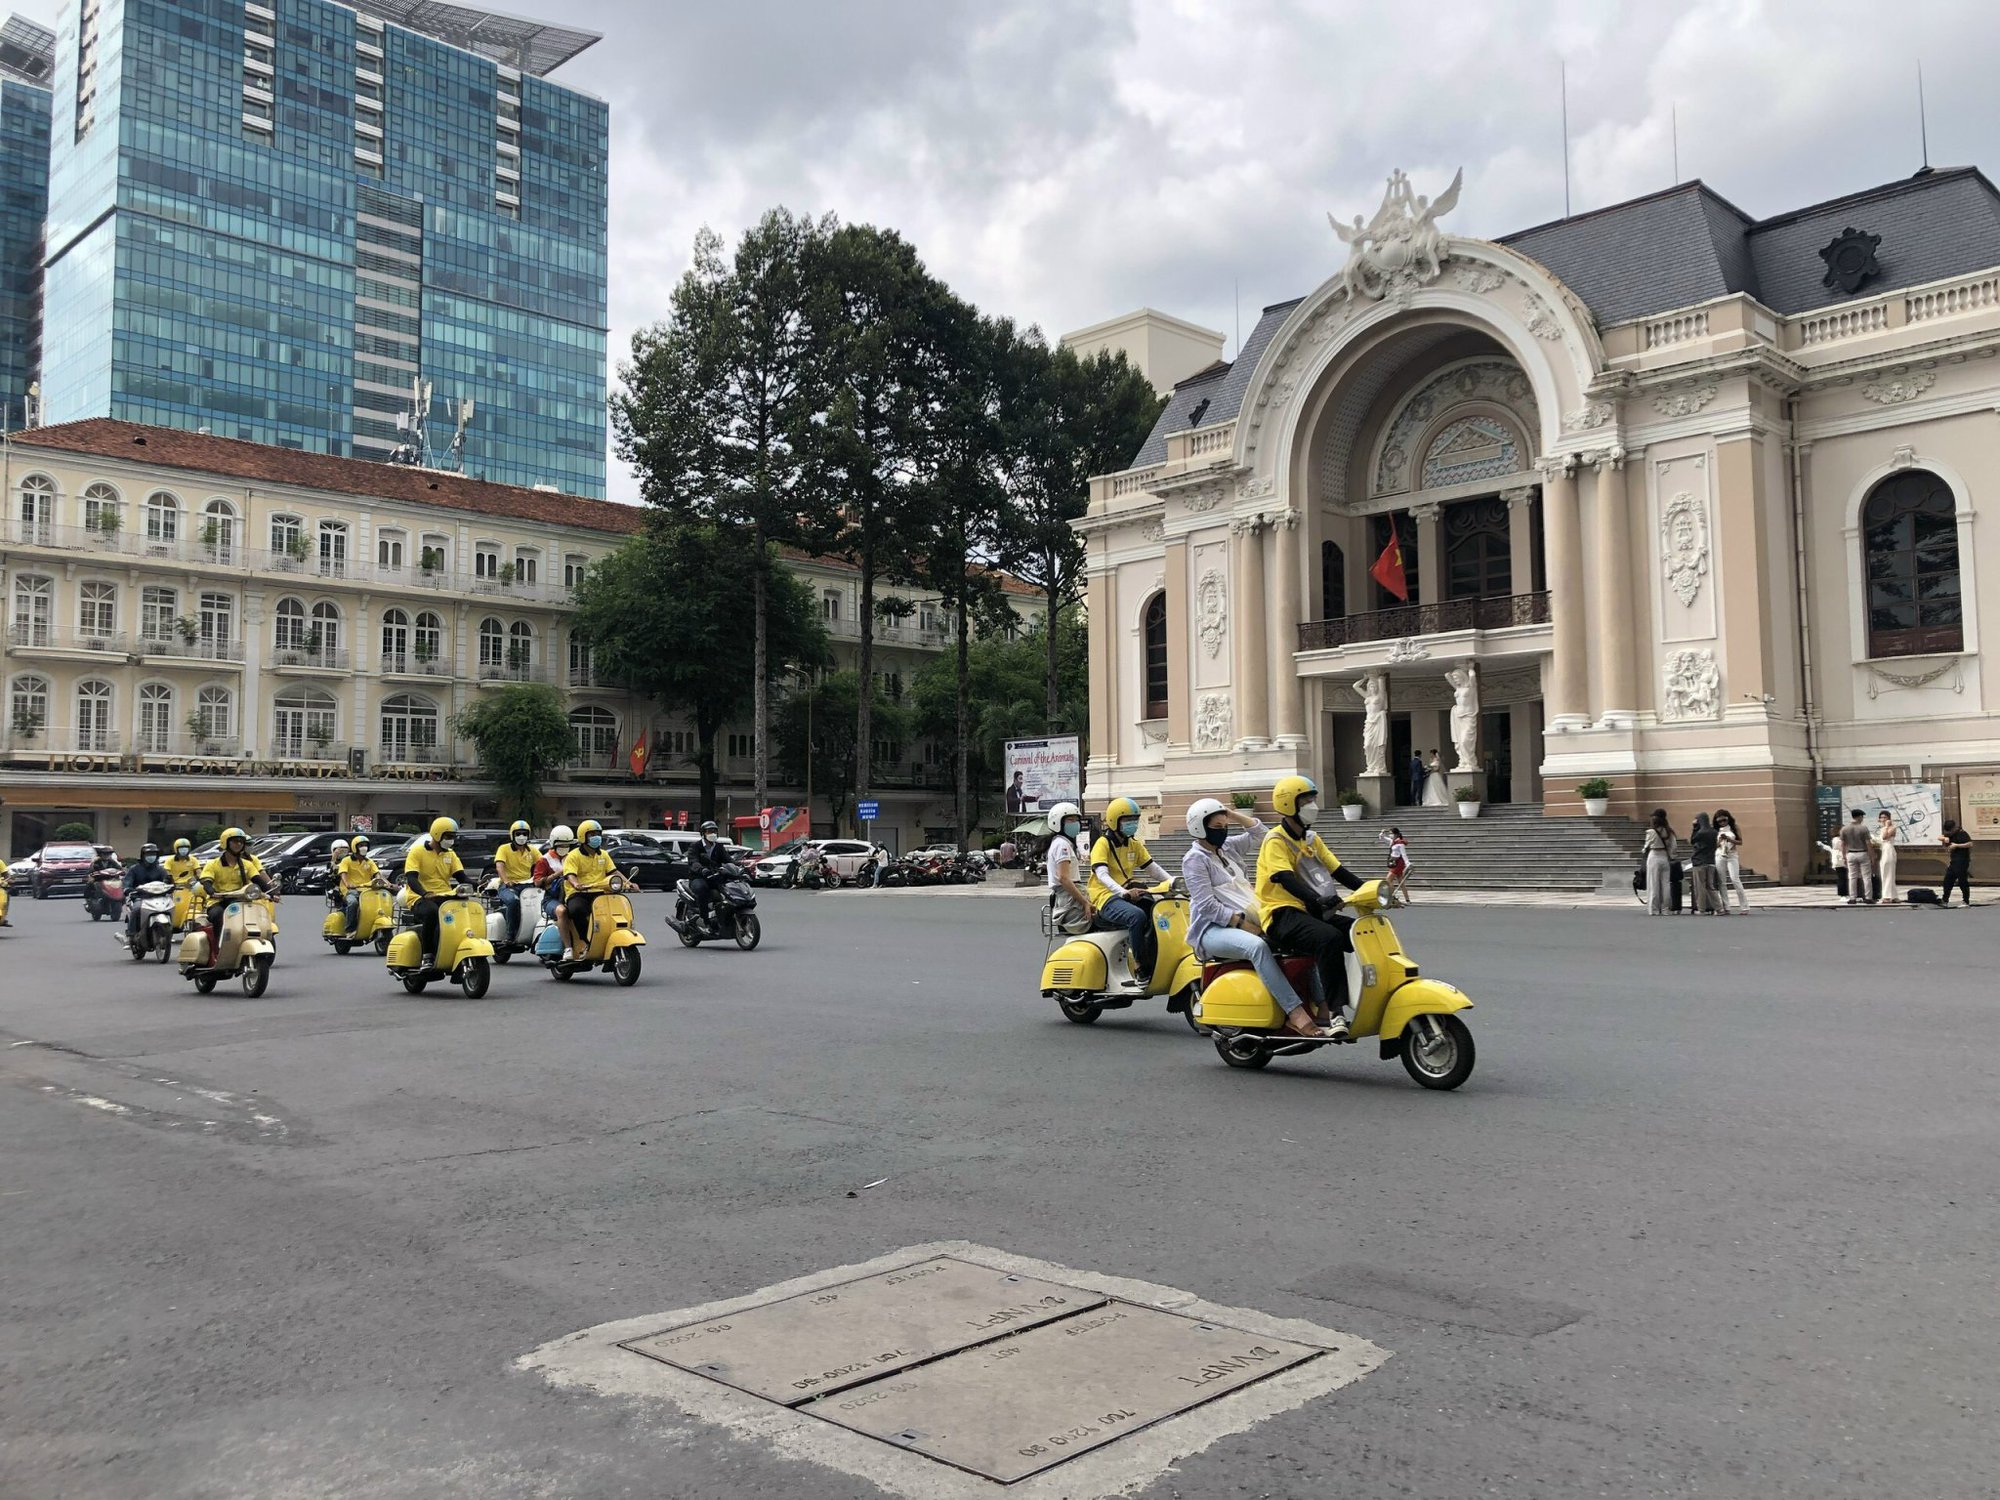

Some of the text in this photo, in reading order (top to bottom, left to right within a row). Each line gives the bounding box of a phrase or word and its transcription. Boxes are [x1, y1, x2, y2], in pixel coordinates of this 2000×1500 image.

[49, 754, 150, 774] HOTEL
[165, 757, 356, 779] CONTINENTAL
[1177, 1354, 1264, 1388] VNPT
